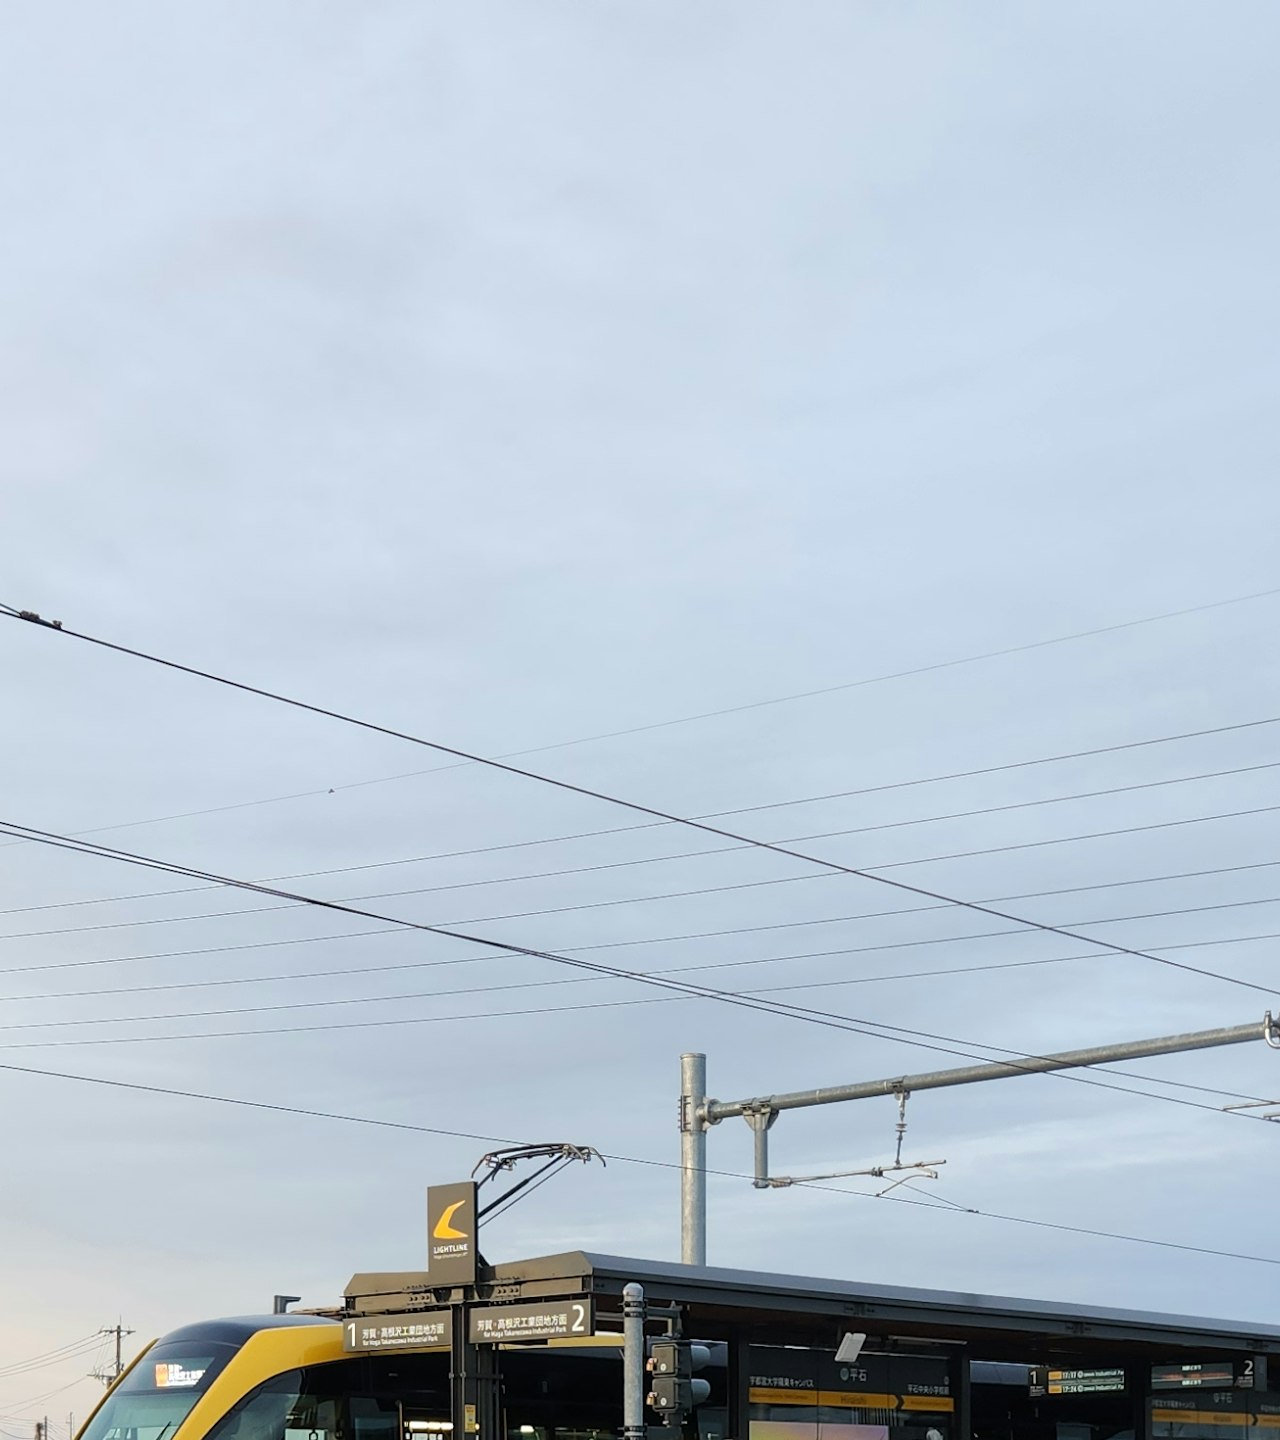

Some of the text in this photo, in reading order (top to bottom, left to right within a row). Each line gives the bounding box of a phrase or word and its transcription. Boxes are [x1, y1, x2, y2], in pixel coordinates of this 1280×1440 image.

[433, 1243, 468, 1254] LIGHTLINE
[572, 1305, 585, 1332] 2
[348, 1323, 356, 1347] 1
[850, 1368, 868, 1382] 平石
[1244, 1361, 1254, 1375] 2
[1030, 1371, 1037, 1384] 1
